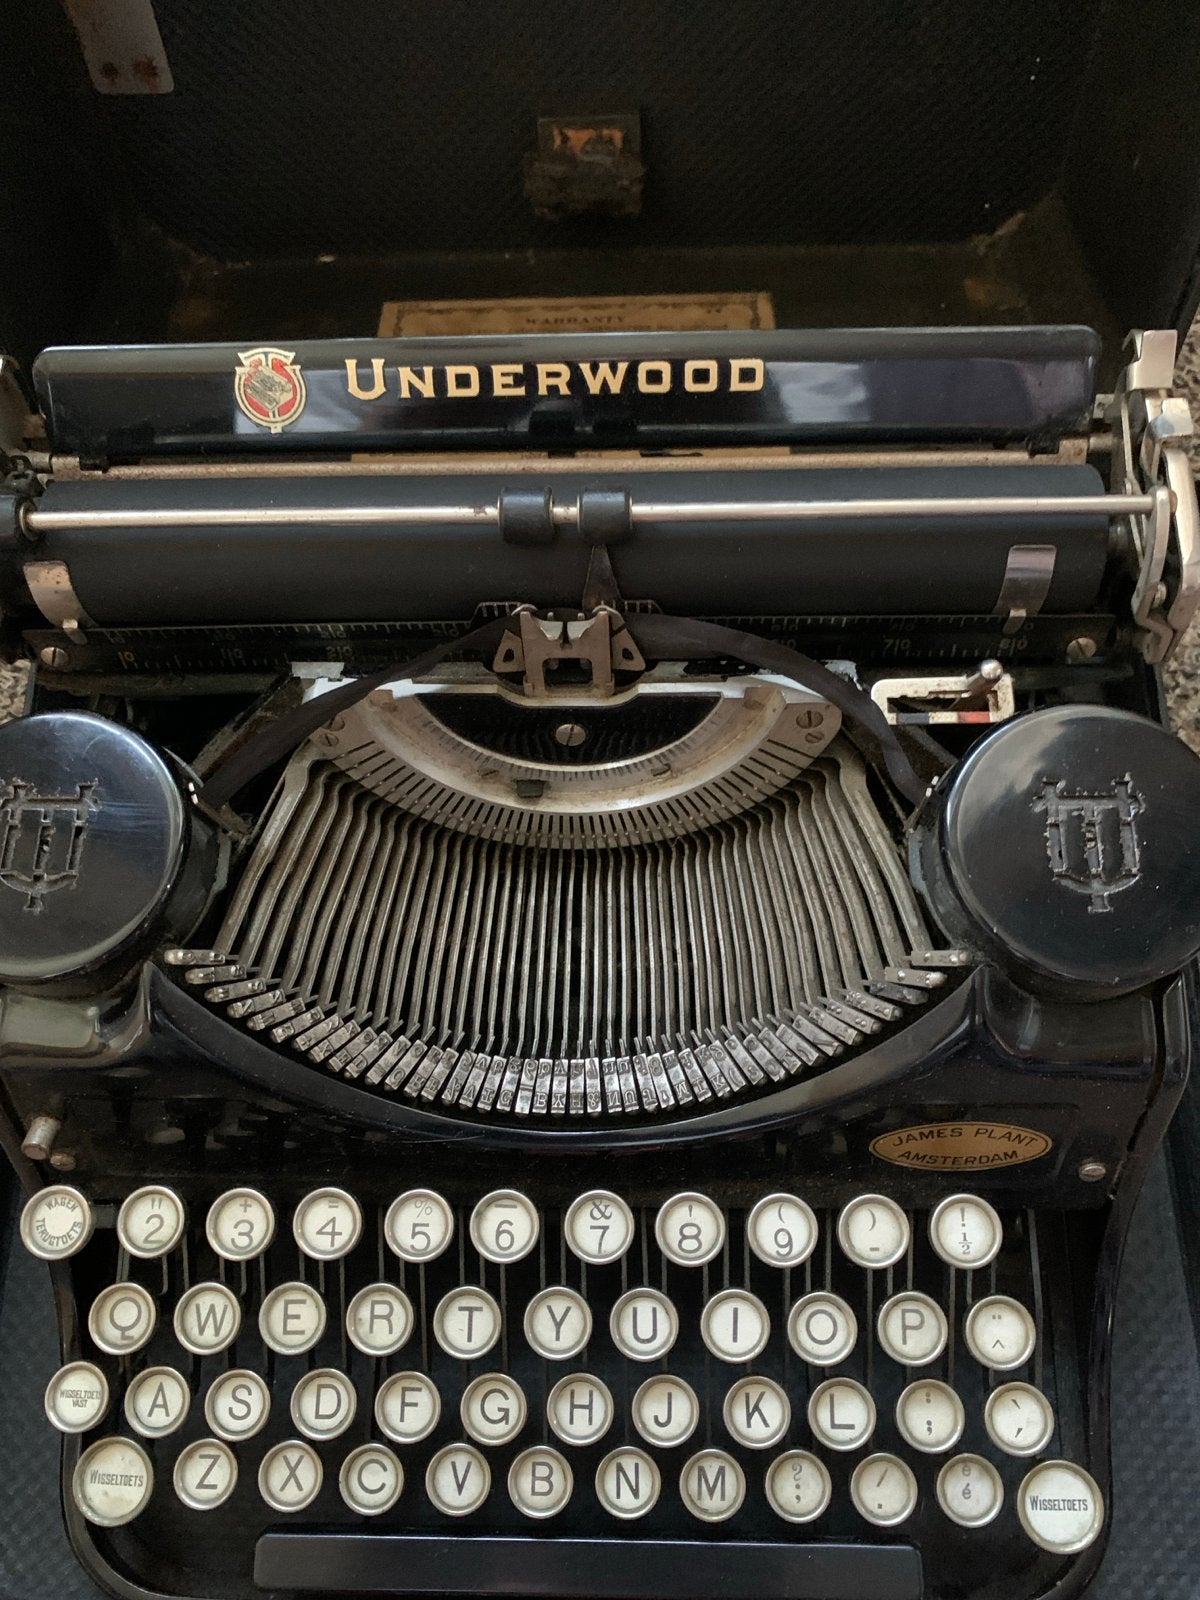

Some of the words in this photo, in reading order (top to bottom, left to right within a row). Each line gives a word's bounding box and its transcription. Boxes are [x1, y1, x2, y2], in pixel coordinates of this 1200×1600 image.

[892, 1127, 963, 1147] JAMES
[974, 1127, 1038, 1147] PLANT
[898, 1150, 1018, 1166] AMSTERDAM
[239, 1199, 252, 1212] +
[414, 1199, 433, 1217] %
[589, 1199, 613, 1221] &
[778, 1203, 785, 1224] (
[868, 1208, 877, 1231] )
[960, 1207, 967, 1228] !
[143, 1214, 165, 1245] 2
[231, 1219, 255, 1250] 3
[316, 1216, 343, 1247] 4
[410, 1223, 431, 1251] 5
[495, 1219, 515, 1251] 6
[589, 1225, 611, 1254] 7
[677, 1222, 702, 1253] 8
[773, 1227, 794, 1256] 9
[109, 1296, 142, 1341] Q
[195, 1303, 229, 1337] W
[282, 1299, 307, 1336] E
[369, 1299, 394, 1335] R
[457, 1306, 483, 1343] T
[546, 1305, 572, 1342] Y
[632, 1306, 658, 1345] U
[732, 1306, 739, 1344] I
[805, 1308, 838, 1346] O
[901, 1308, 925, 1345] P
[72, 1400, 88, 1408] VAST
[147, 1381, 170, 1418] A
[228, 1384, 252, 1421] S
[314, 1384, 341, 1420] D
[399, 1386, 422, 1423] F
[480, 1388, 510, 1425] G
[569, 1389, 594, 1426] H
[653, 1392, 673, 1428] J
[744, 1390, 770, 1429] K
[829, 1393, 855, 1430] L
[195, 1454, 221, 1490] Z
[279, 1455, 304, 1492] X
[357, 1458, 388, 1495] C
[450, 1461, 472, 1497] V
[530, 1461, 555, 1497] B
[616, 1462, 640, 1500] N
[697, 1465, 727, 1502] M
